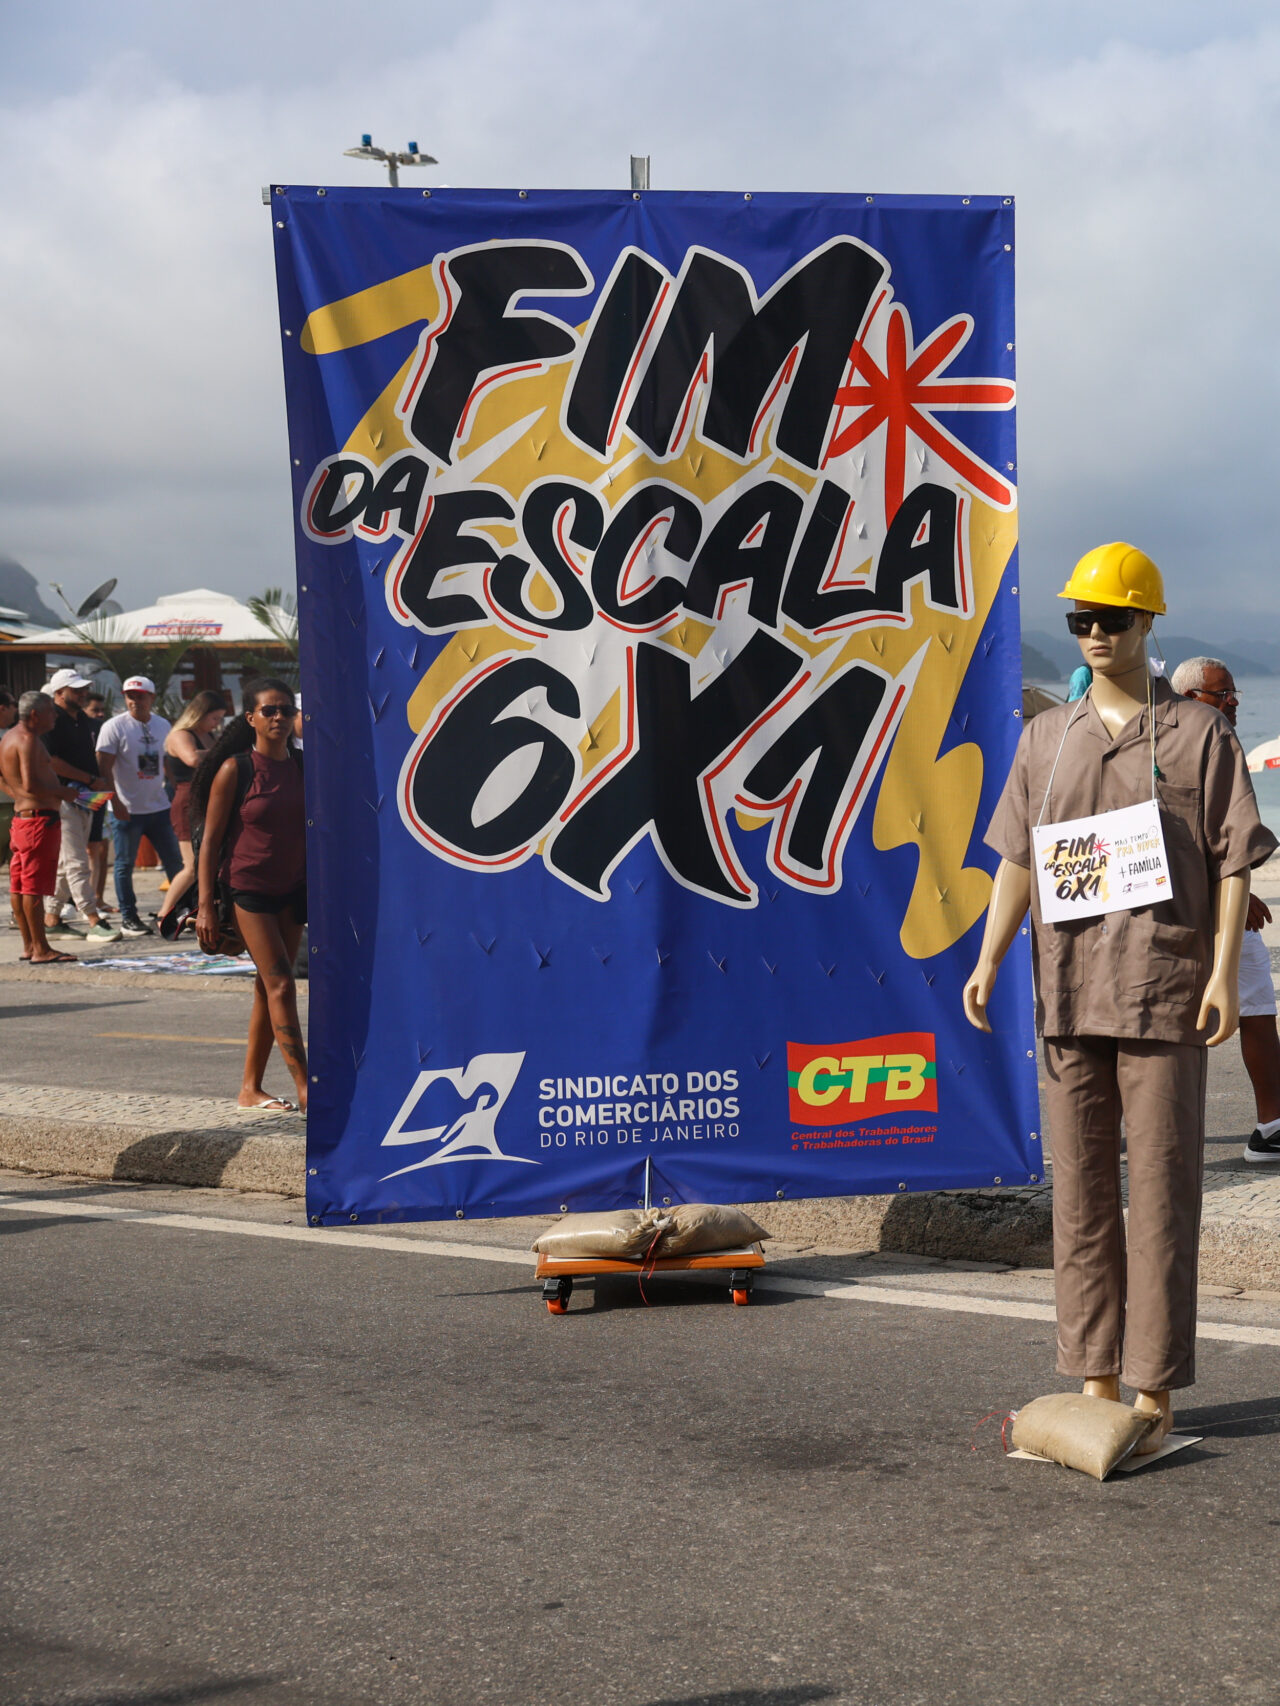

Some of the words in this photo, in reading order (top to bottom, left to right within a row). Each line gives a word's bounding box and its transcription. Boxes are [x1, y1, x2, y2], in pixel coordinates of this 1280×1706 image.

[404, 236, 890, 472] FIM
[308, 454, 431, 541] DA
[396, 480, 968, 634] ESCALA
[405, 628, 904, 907] 6X1
[1053, 832, 1097, 861] FIM
[1116, 844, 1134, 858] PRA
[1130, 832, 1149, 843] TEMPO
[1044, 863, 1056, 871] DA
[1053, 855, 1107, 878] ESCALA
[1128, 856, 1161, 876] FAMÍLIA
[1055, 873, 1101, 902] 6X1
[538, 1073, 679, 1100] SINDICATO
[687, 1069, 739, 1093] DOS
[797, 1053, 927, 1107] CTB
[538, 1096, 740, 1128] COMERCIÁRIOS
[540, 1132, 567, 1148] DO
[575, 1130, 608, 1146] RIO
[617, 1128, 643, 1144] DE
[650, 1123, 740, 1142] JANEIRO
[791, 1129, 832, 1140] Central
[835, 1129, 855, 1138] dos
[859, 1125, 938, 1137] Trabalhadores
[803, 1139, 881, 1150] Trabalhadoras
[885, 1136, 898, 1145] do
[902, 1134, 934, 1144] Brasil
